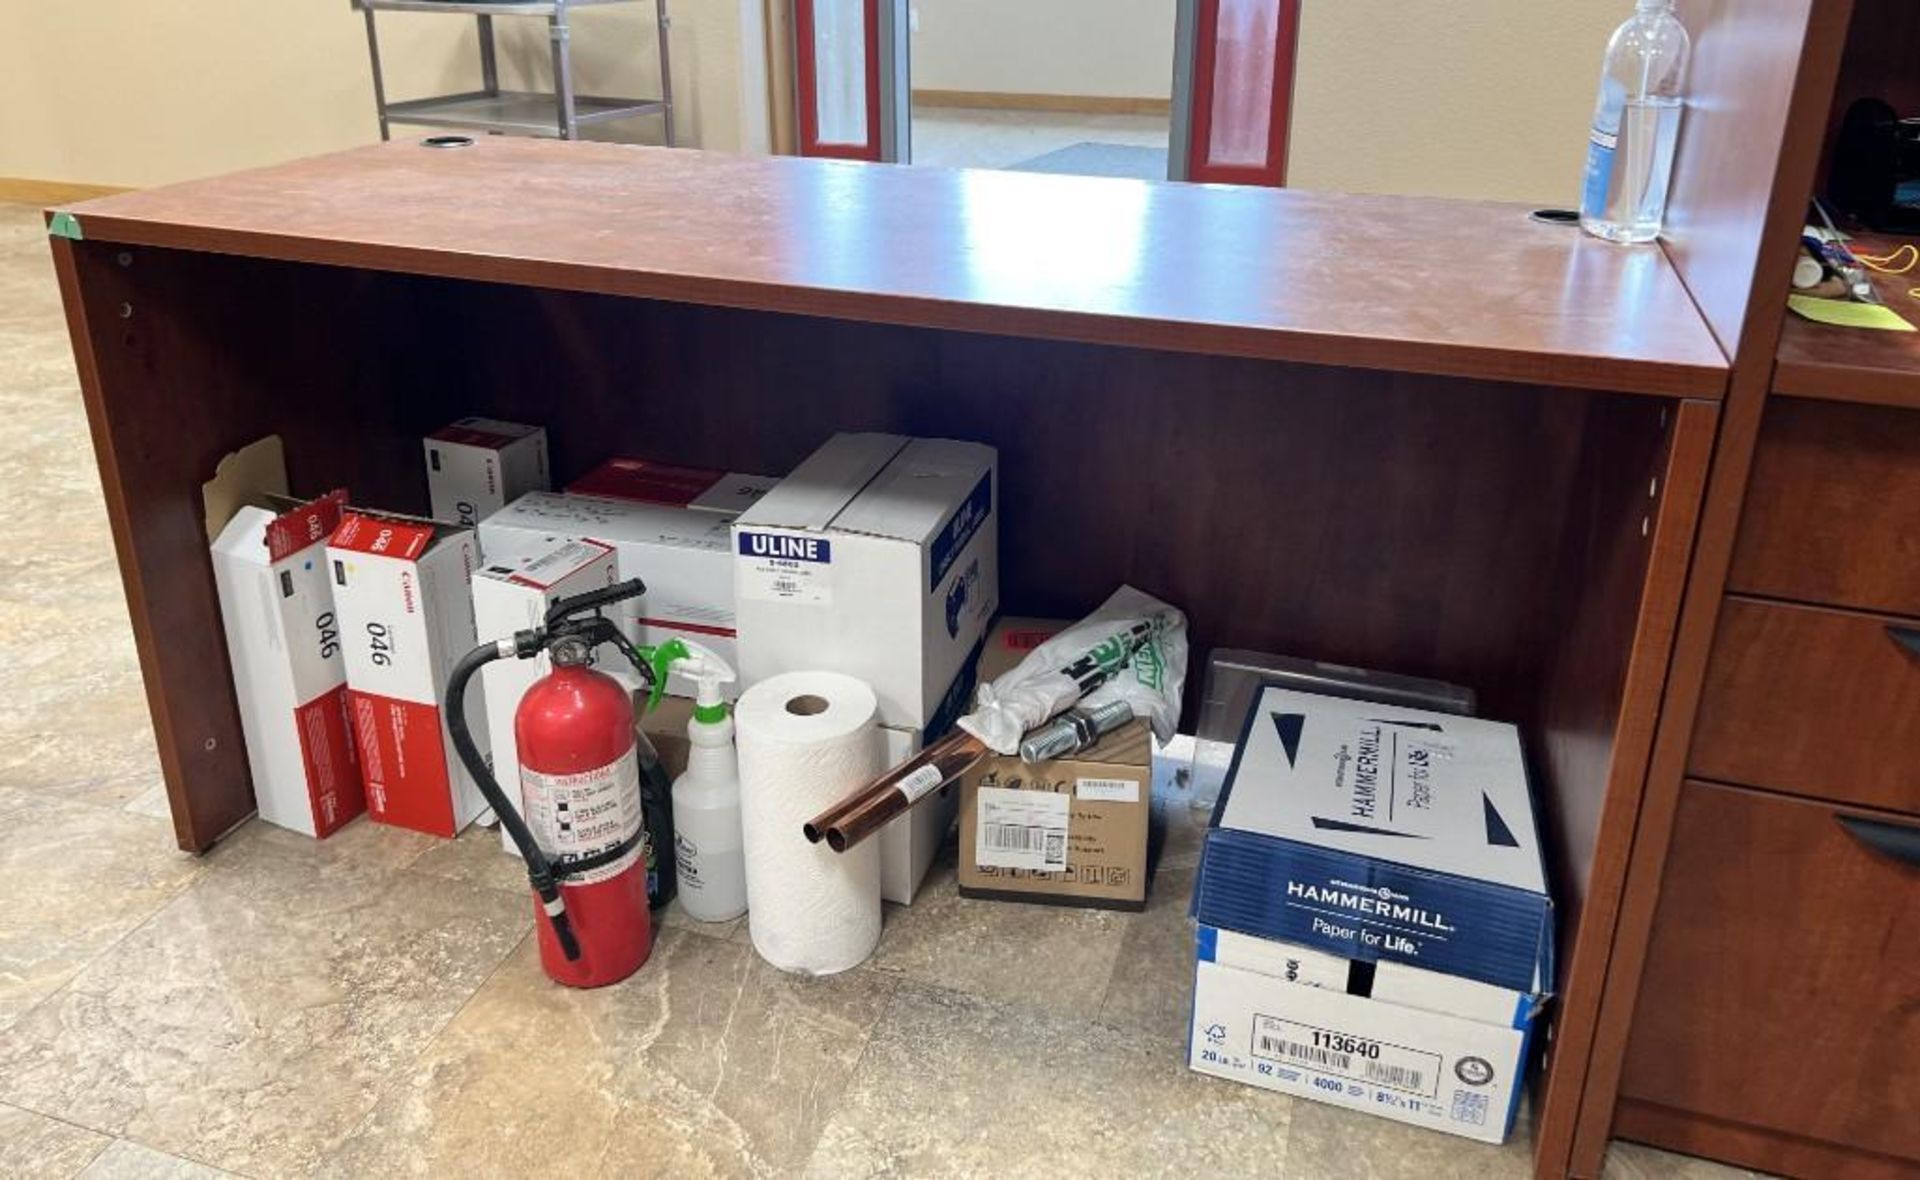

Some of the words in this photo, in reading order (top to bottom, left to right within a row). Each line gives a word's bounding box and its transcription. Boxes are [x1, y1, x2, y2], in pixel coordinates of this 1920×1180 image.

[751, 534, 818, 560] ULINE
[402, 570, 415, 614] Canon
[315, 611, 340, 660] 046
[366, 622, 392, 666] 046
[1351, 726, 1382, 819] HAMMERMILL
[1312, 917, 1355, 940] Paper
[1360, 927, 1382, 945] for
[1202, 1050, 1217, 1062] 20
[1312, 1031, 1380, 1060] 113640
[1257, 1063, 1274, 1076] 92
[1313, 1077, 1344, 1093] 4000
